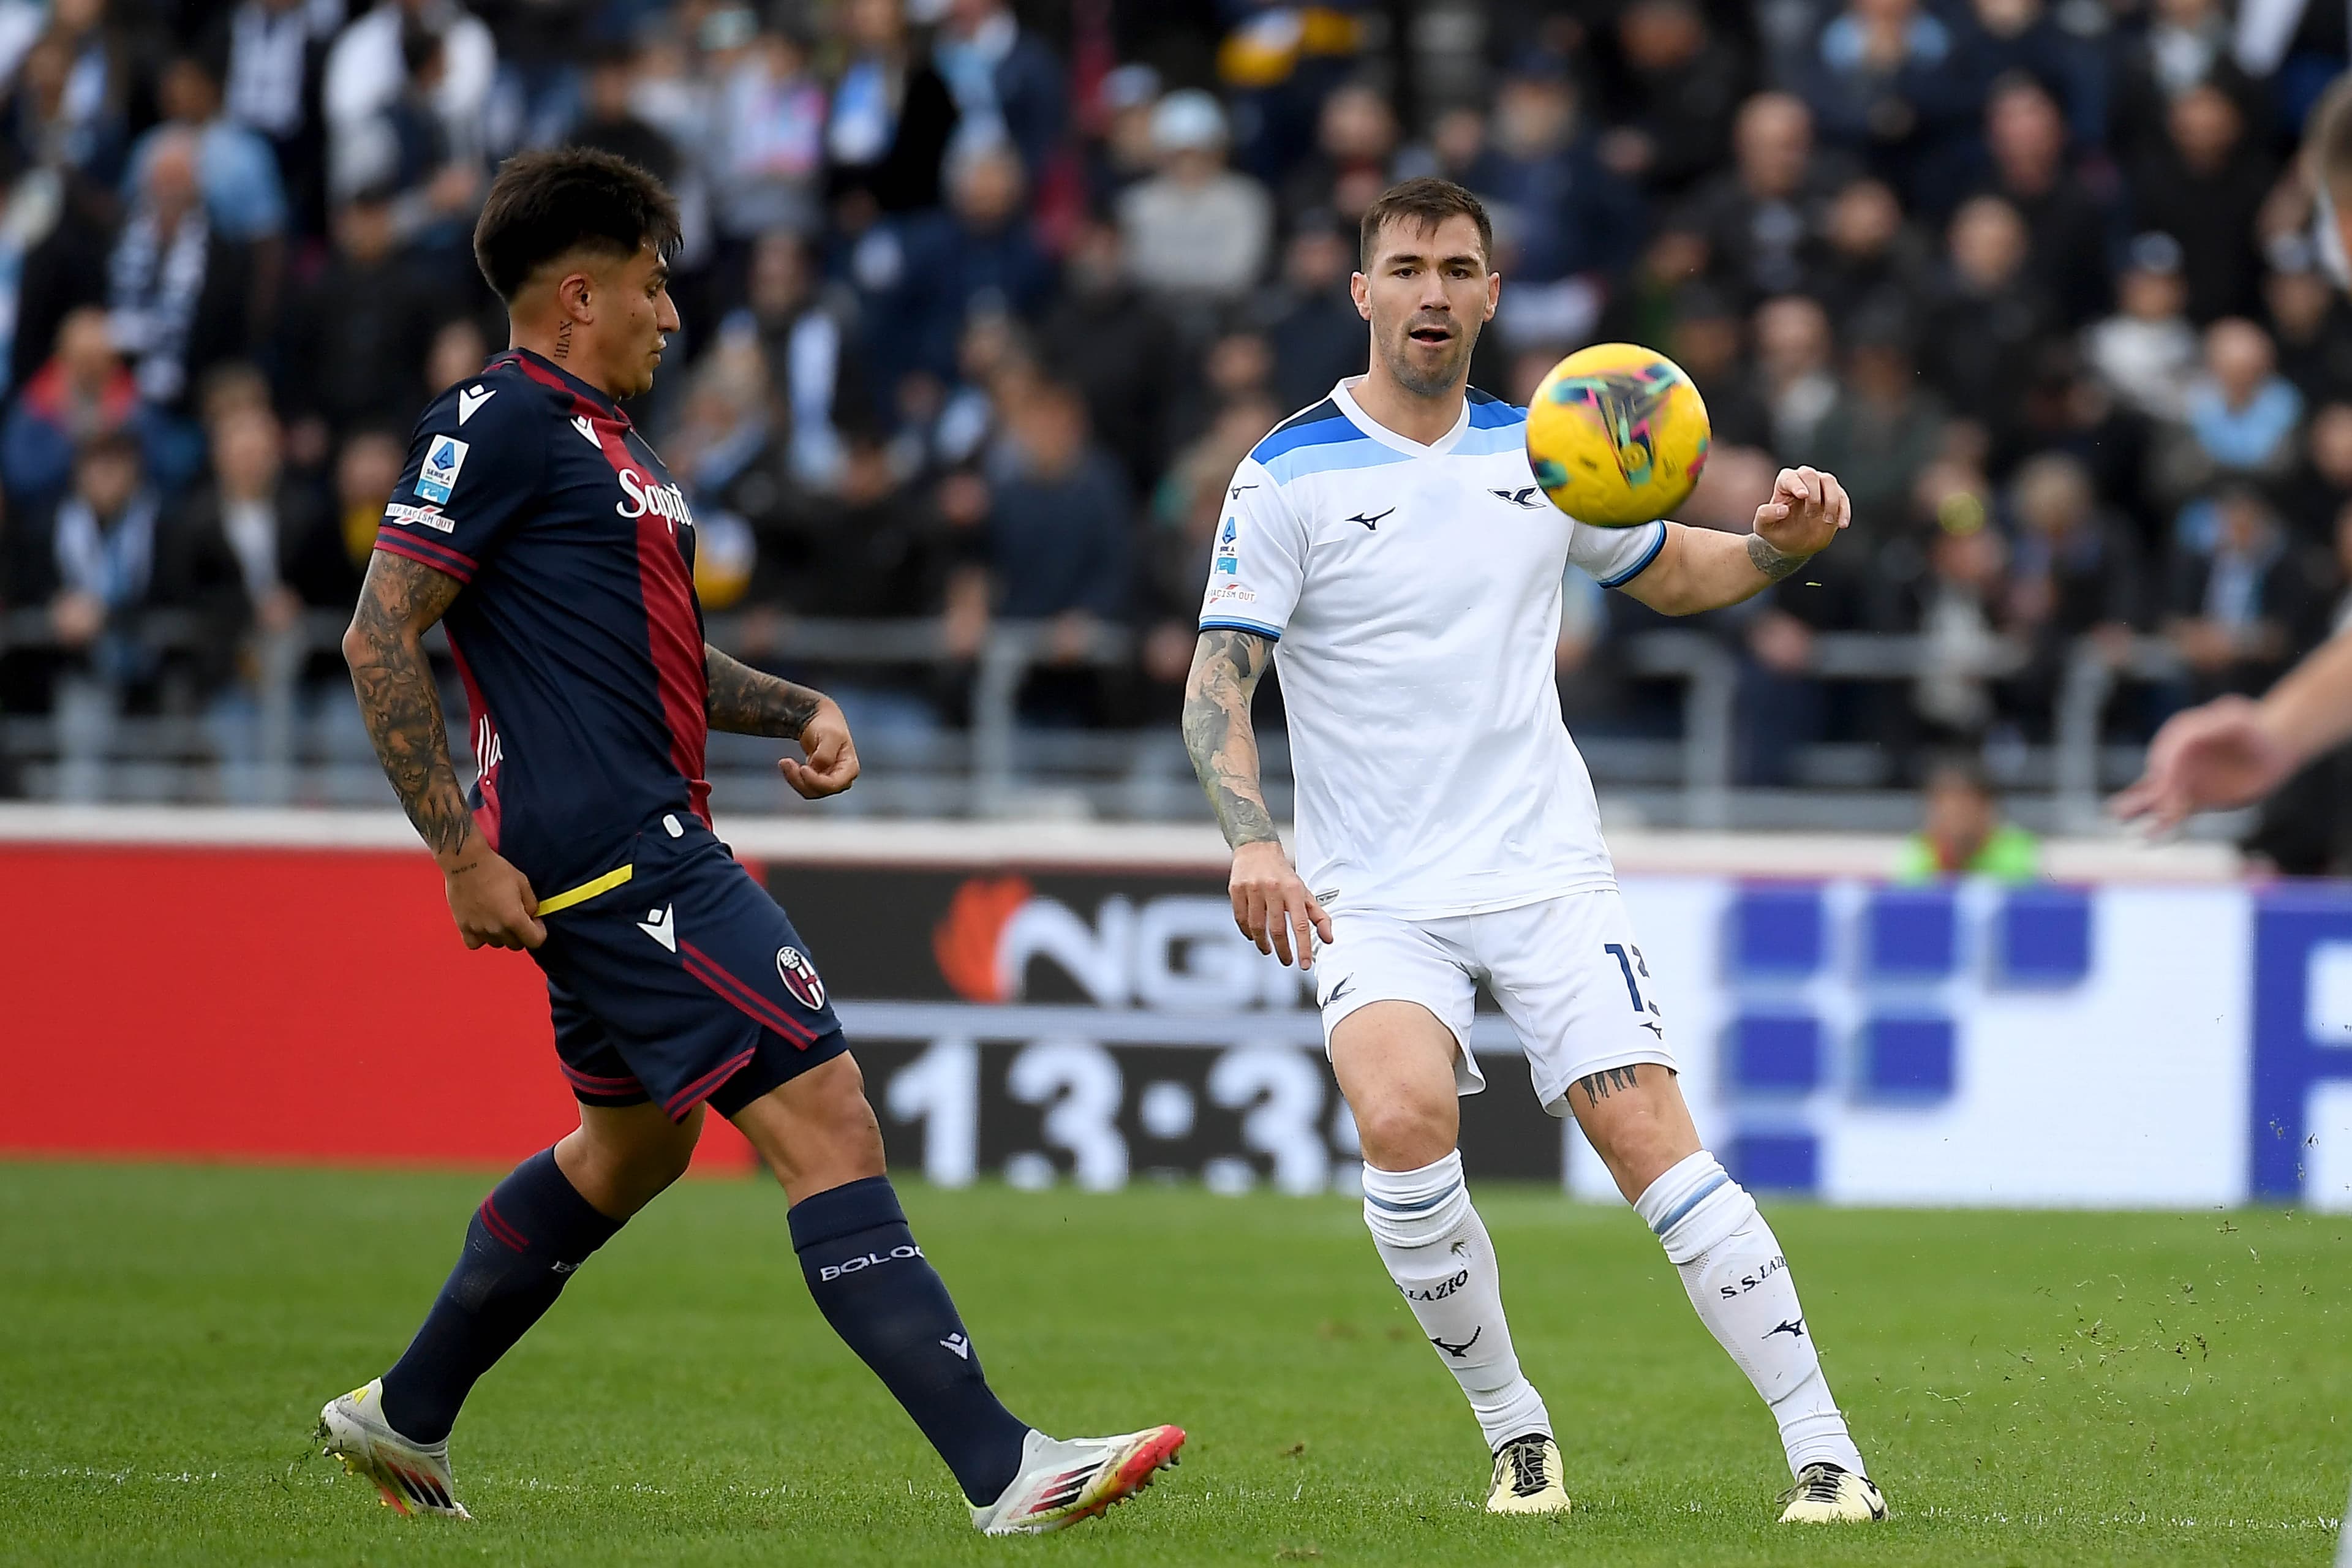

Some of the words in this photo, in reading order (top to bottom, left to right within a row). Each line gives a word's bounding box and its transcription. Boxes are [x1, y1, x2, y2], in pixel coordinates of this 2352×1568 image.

[402, 508, 434, 525] RACISM
[435, 518, 453, 530] OUT
[1238, 591, 1255, 601] OUT
